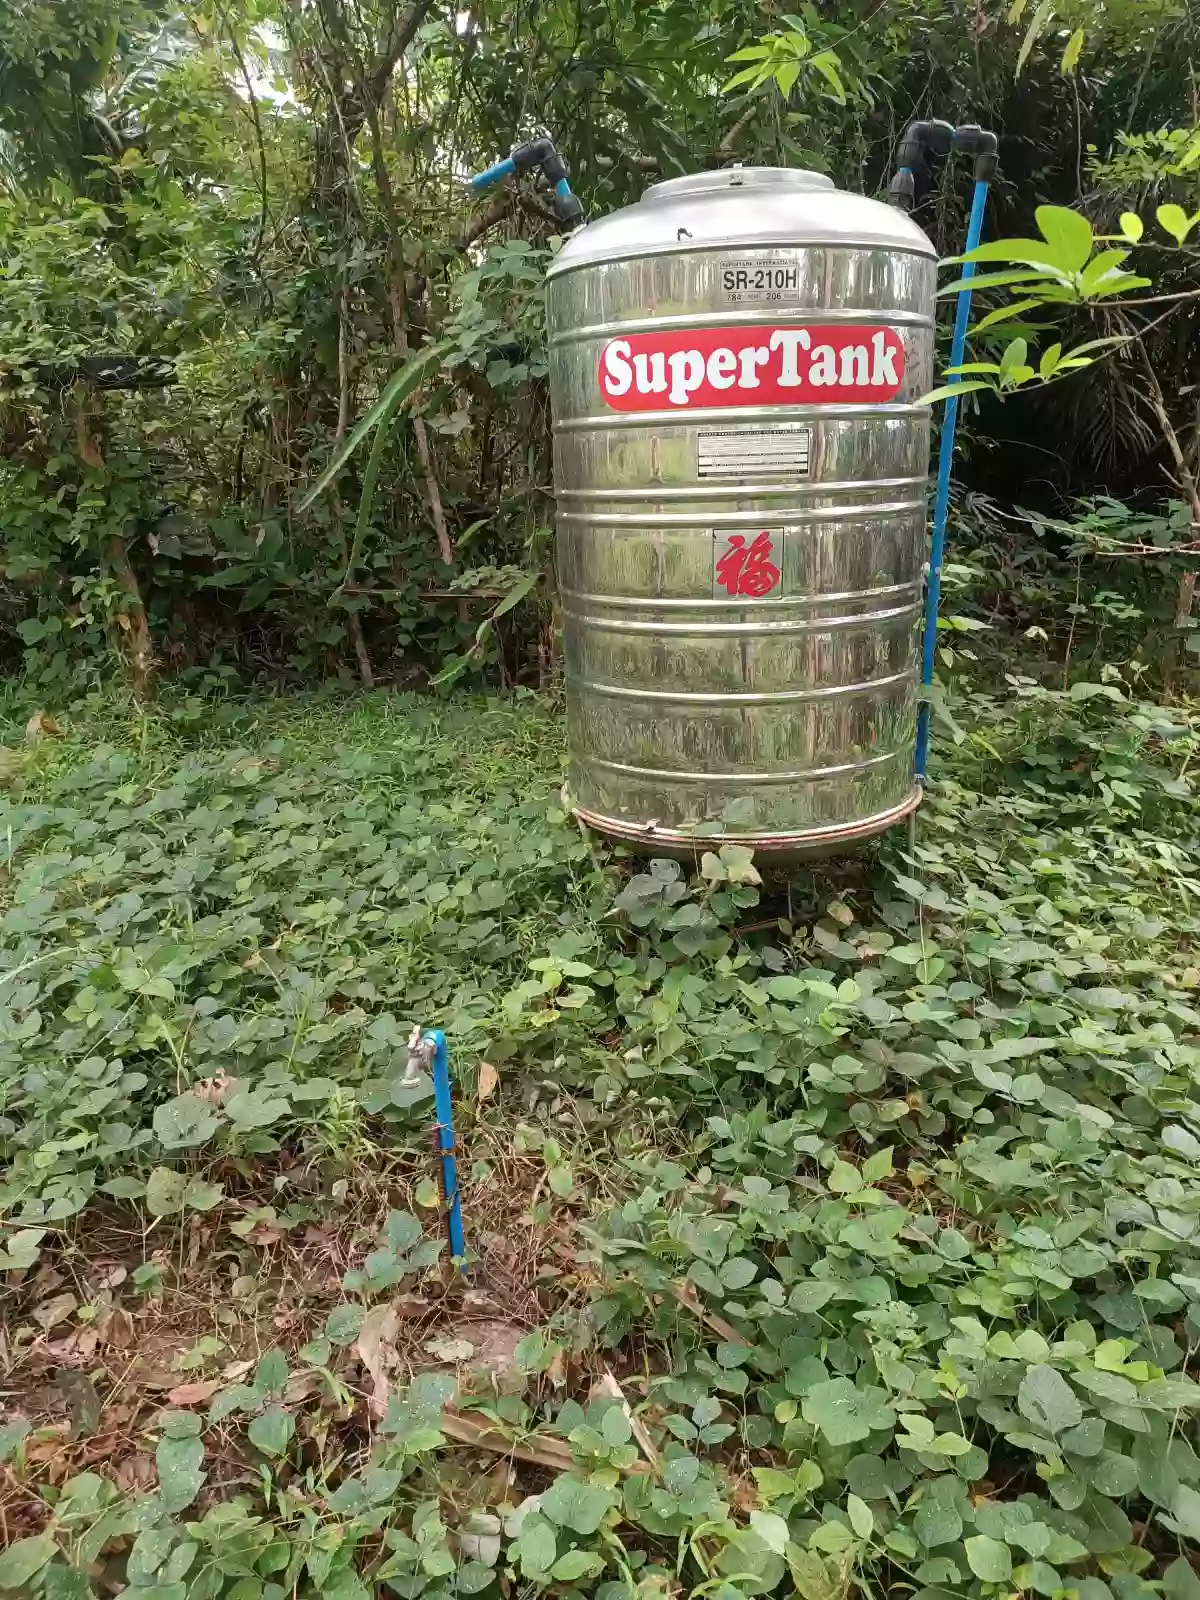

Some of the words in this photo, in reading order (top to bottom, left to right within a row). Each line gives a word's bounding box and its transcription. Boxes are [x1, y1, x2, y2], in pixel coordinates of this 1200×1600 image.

[723, 268, 797, 290] SR-210H
[605, 329, 899, 404] SuperTank
[716, 531, 781, 597] 福
